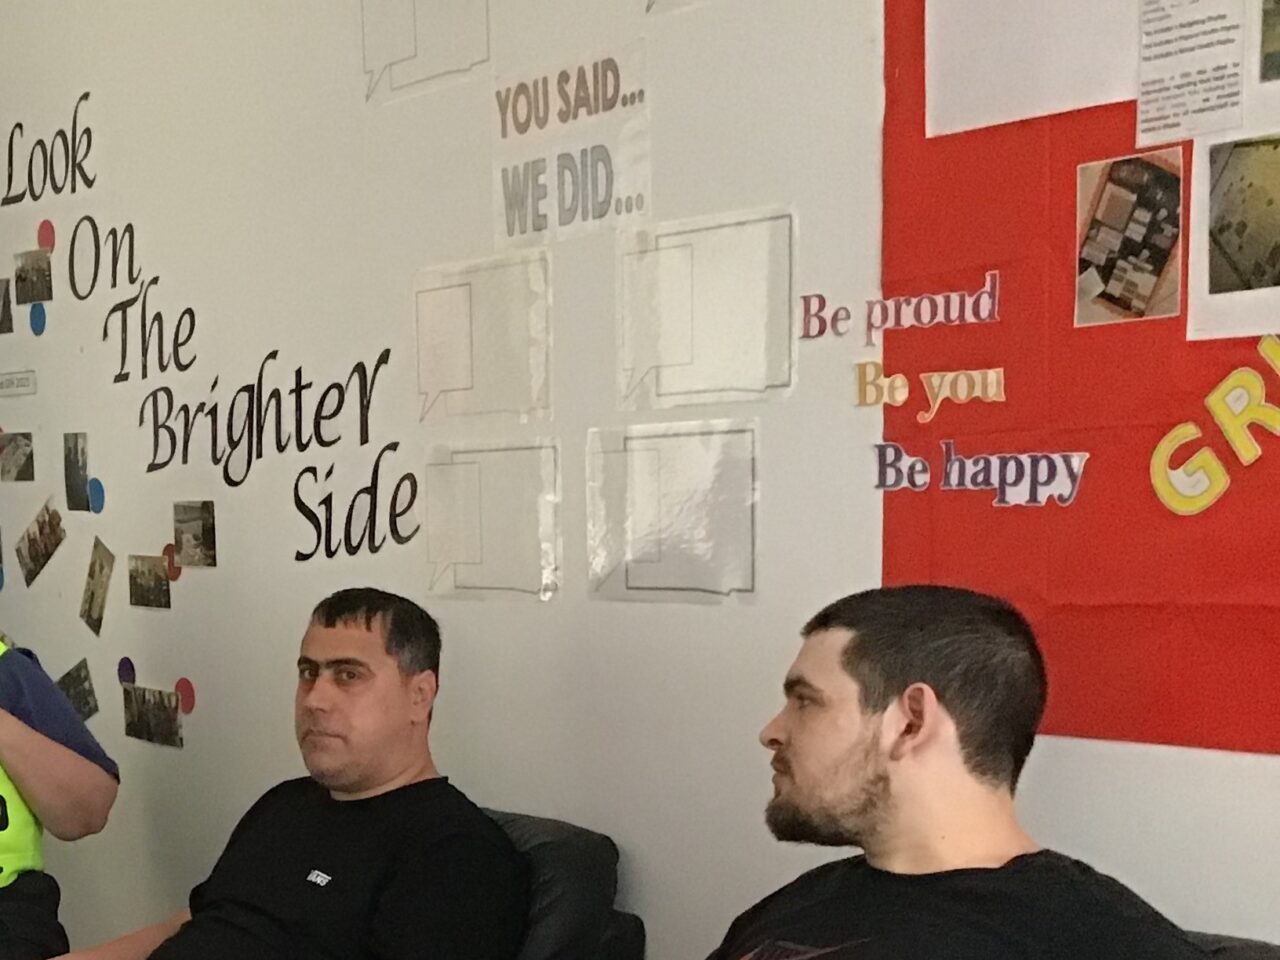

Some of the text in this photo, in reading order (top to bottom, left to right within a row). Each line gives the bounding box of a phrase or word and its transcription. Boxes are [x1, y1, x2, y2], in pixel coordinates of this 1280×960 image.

[495, 57, 645, 139] YOU SAID...
[0, 91, 97, 206] Look
[501, 144, 645, 238] WE DID...
[68, 214, 143, 301] On
[101, 276, 198, 383] The
[799, 270, 1000, 347] Be proud
[138, 348, 393, 488] Brighter
[854, 361, 1007, 424] Be you
[292, 441, 422, 562] Side
[874, 439, 1090, 507] Be happy
